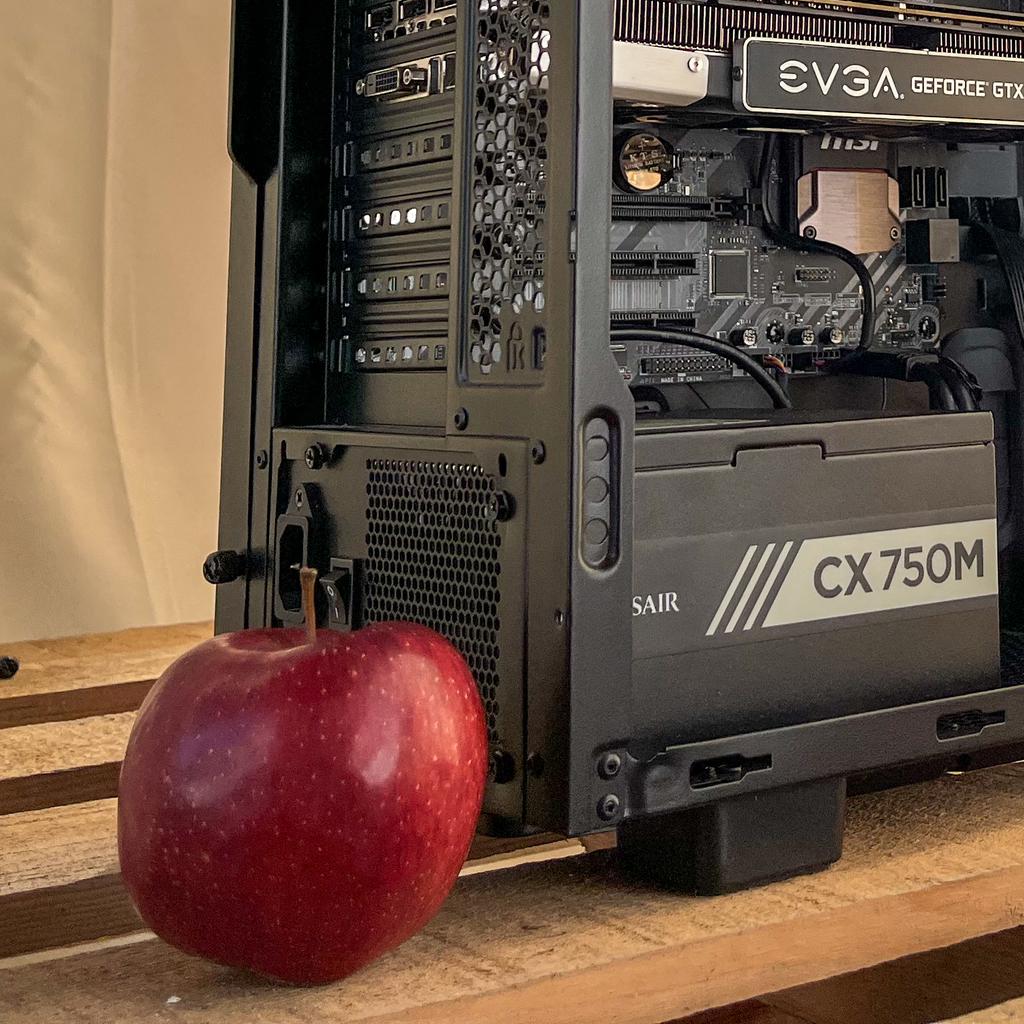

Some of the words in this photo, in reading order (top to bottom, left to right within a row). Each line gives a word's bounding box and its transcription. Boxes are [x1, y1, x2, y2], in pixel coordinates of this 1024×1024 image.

[779, 59, 900, 99] EVGA
[911, 76, 986, 97] GEFORCE
[992, 82, 1024, 99] GTX
